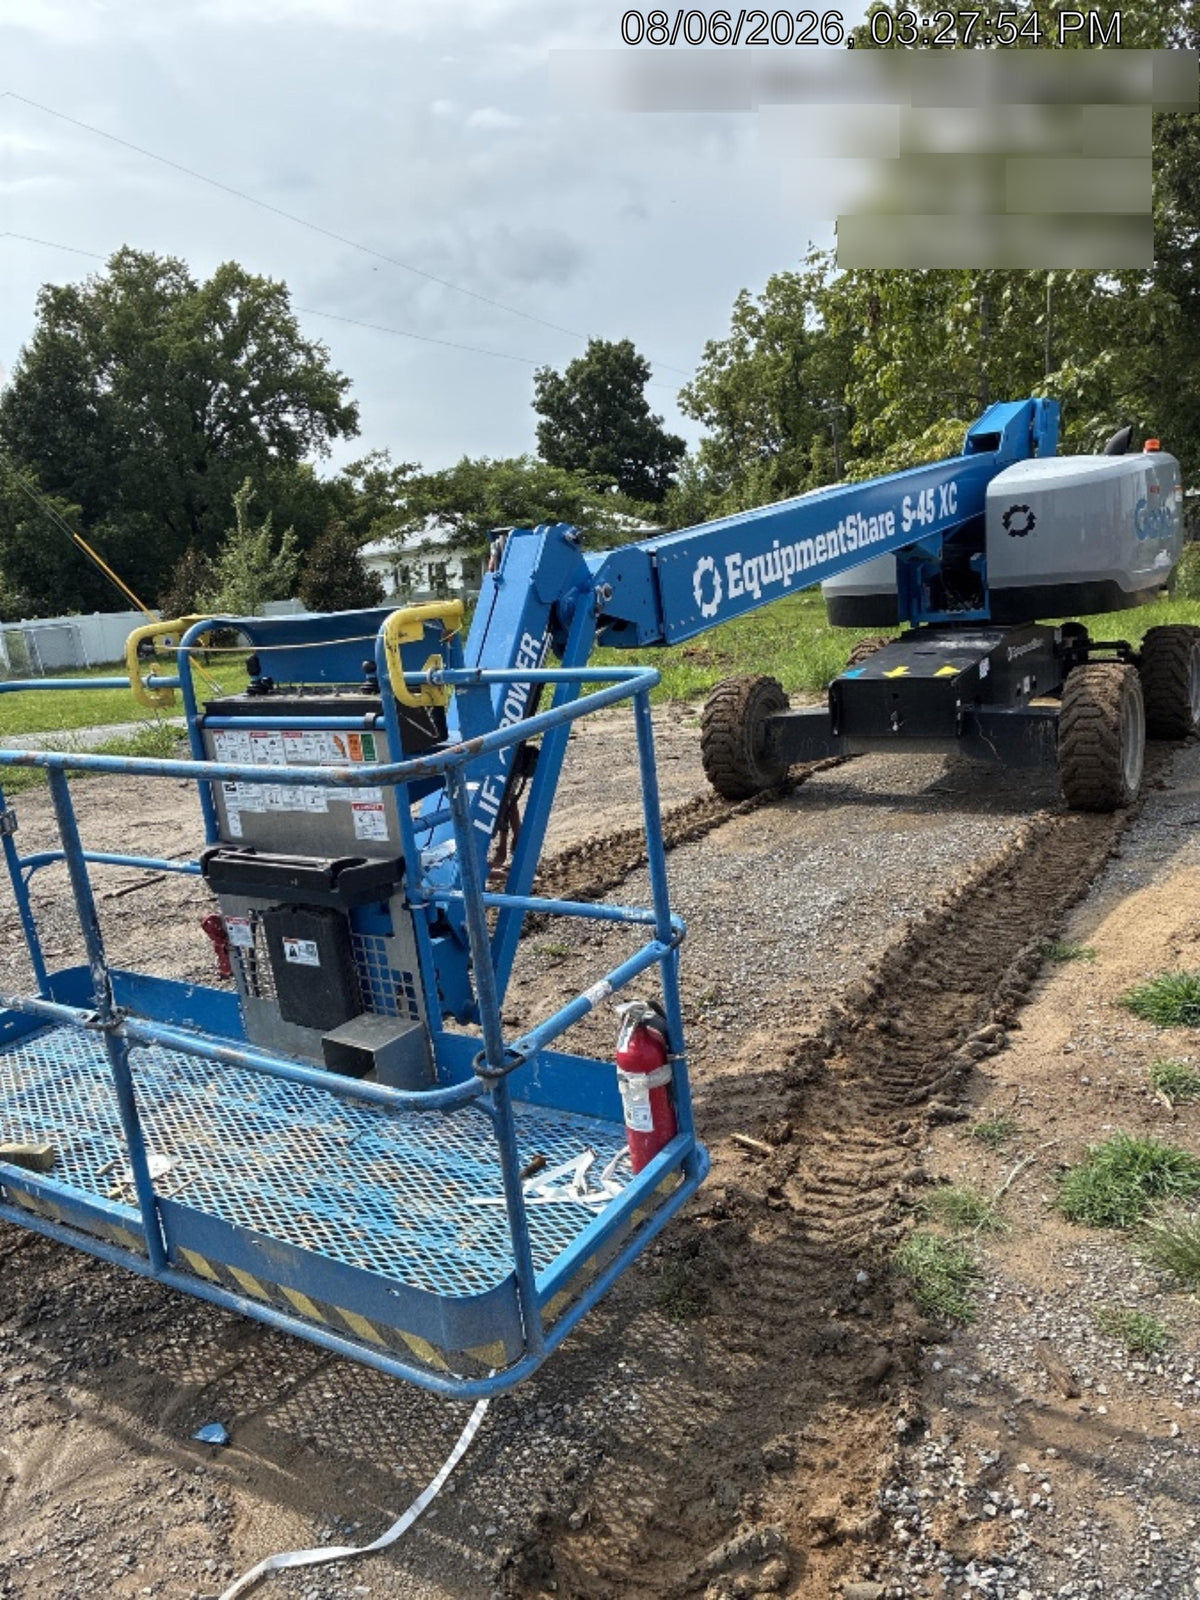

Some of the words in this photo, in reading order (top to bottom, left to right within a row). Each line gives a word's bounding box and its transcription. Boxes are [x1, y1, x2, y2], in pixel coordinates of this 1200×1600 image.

[725, 510, 895, 599] EquipmentShare
[901, 495, 935, 532] S-45
[938, 481, 958, 519] XC
